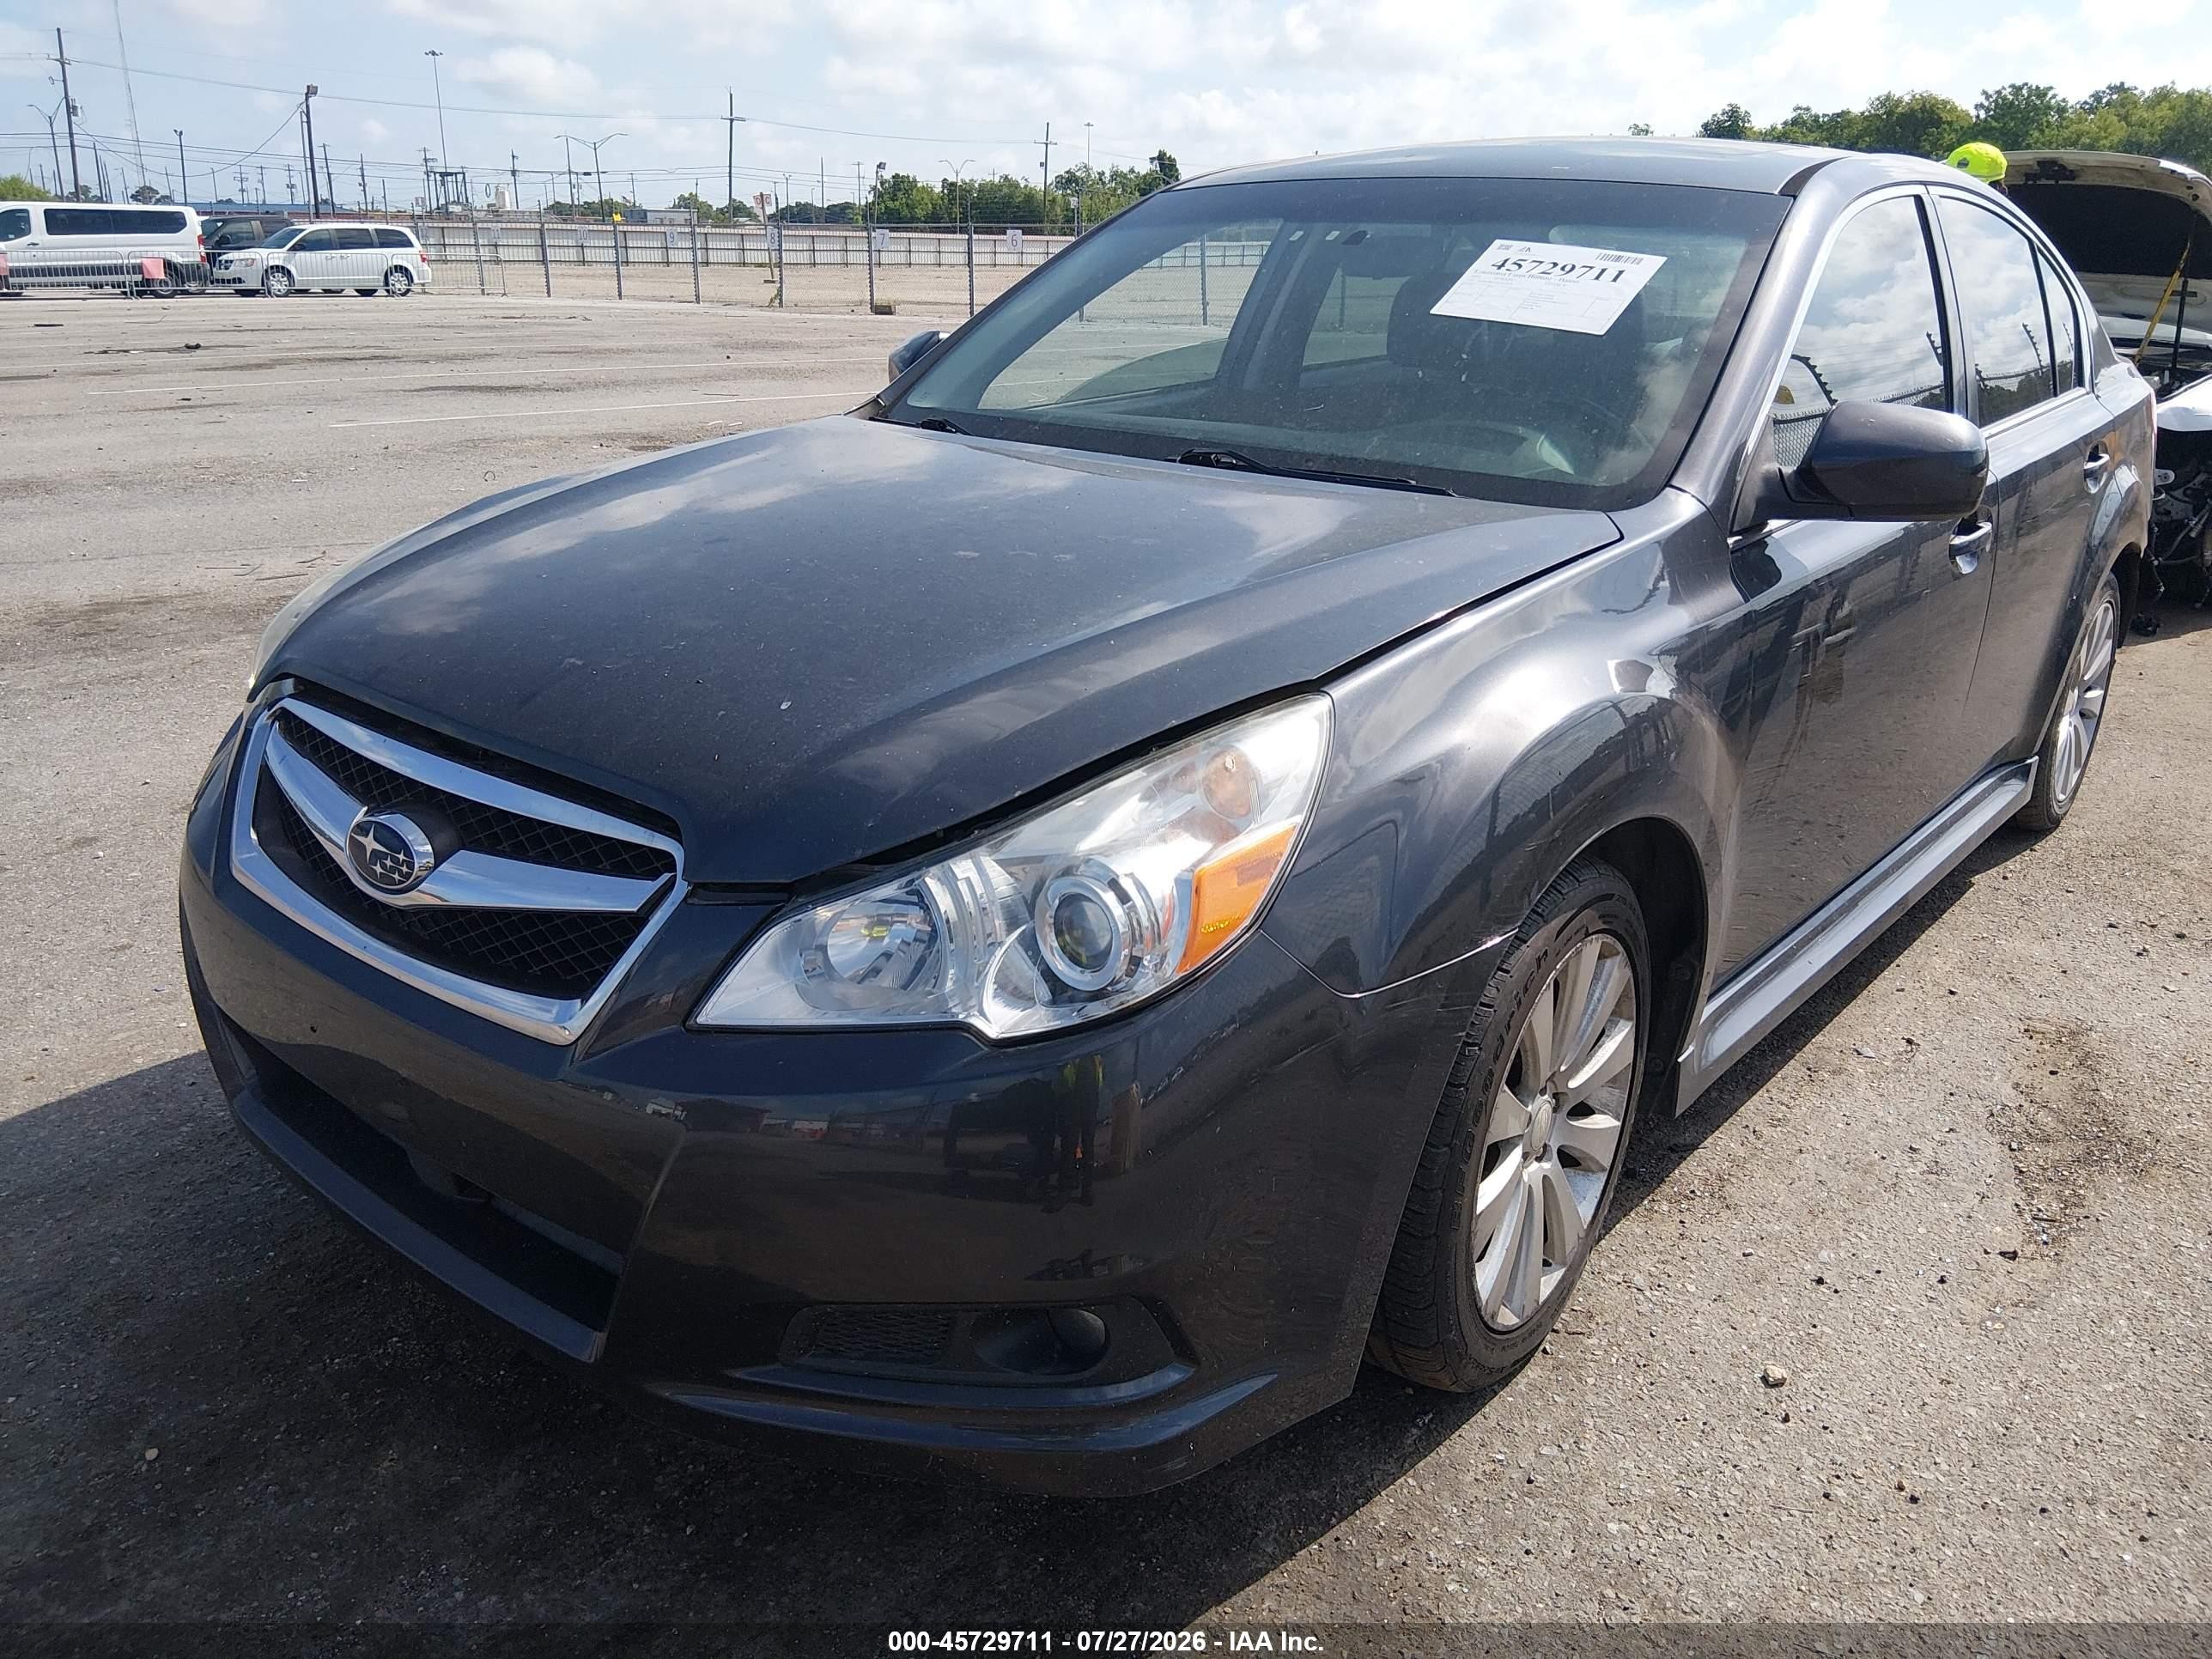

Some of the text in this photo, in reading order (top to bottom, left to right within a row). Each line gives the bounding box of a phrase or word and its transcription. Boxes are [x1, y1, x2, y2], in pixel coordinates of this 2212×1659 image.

[579, 229, 588, 240] 10
[769, 232, 776, 245] 8
[879, 233, 885, 246] 7
[1011, 234, 1018, 247] 6
[1491, 257, 1626, 283] 45729711
